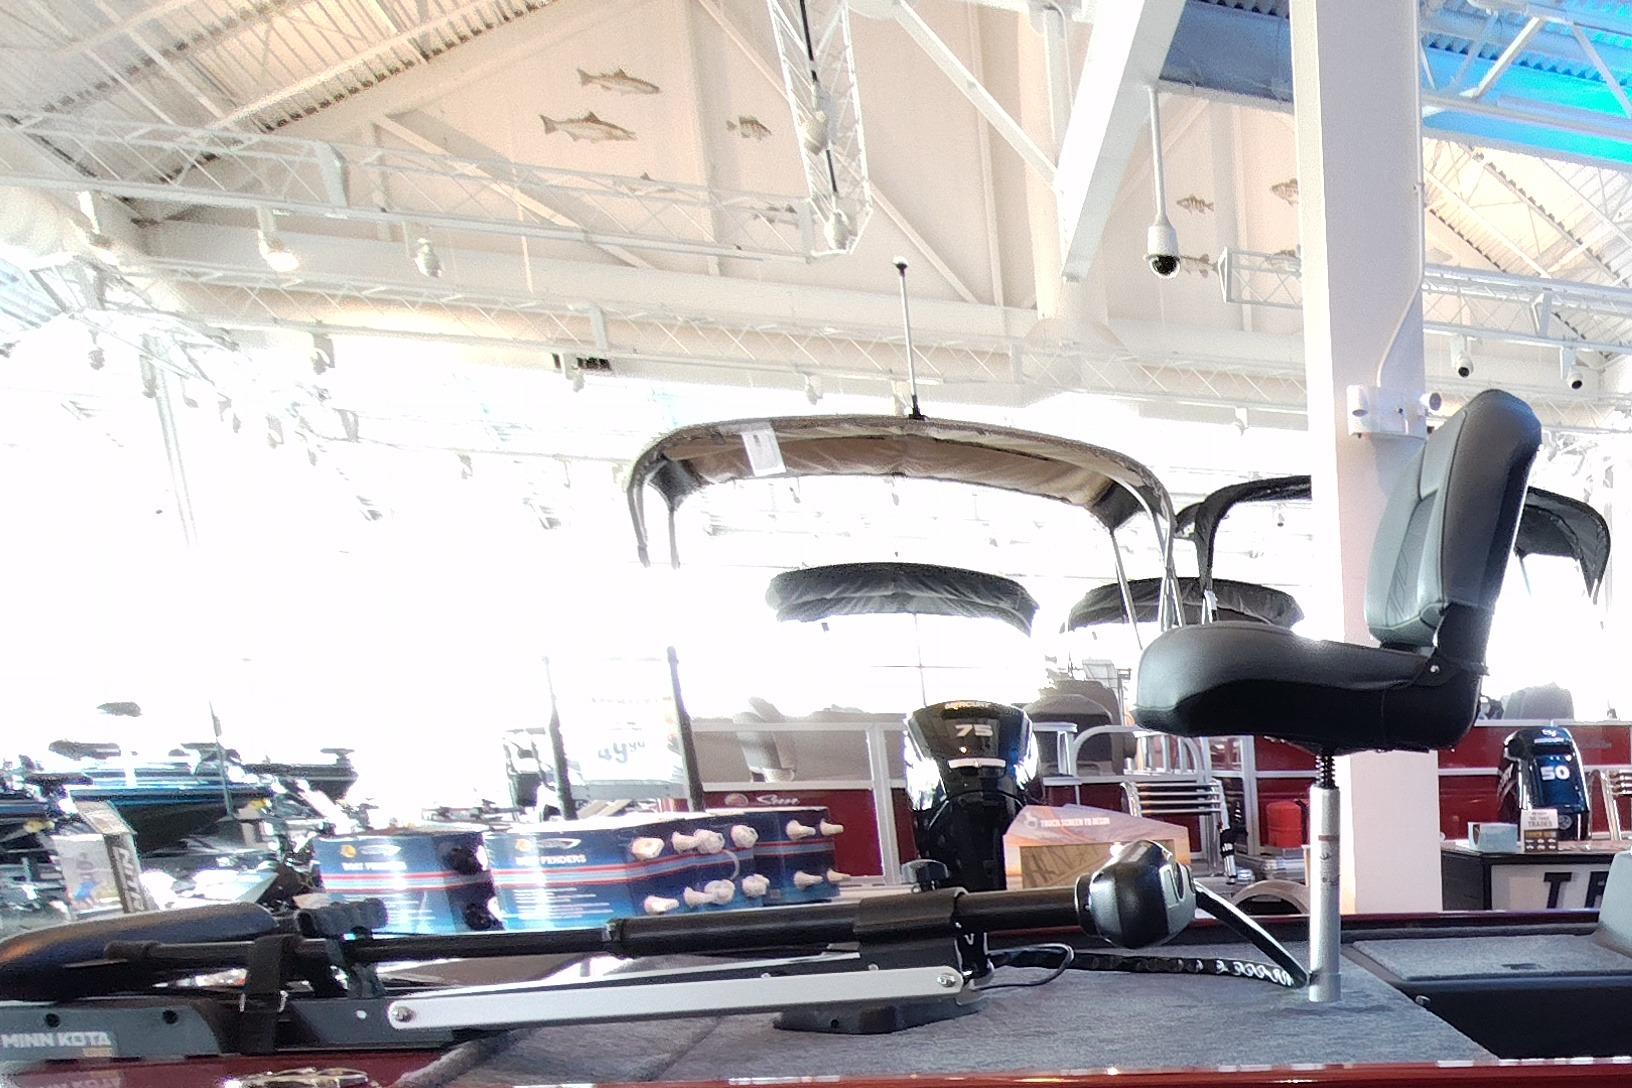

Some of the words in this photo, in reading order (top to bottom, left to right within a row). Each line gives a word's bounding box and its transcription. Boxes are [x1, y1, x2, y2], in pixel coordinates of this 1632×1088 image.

[955, 724, 993, 737] 75
[1541, 765, 1570, 781] 50
[1, 1033, 54, 1048] MINN
[57, 1031, 112, 1047] KOTA
